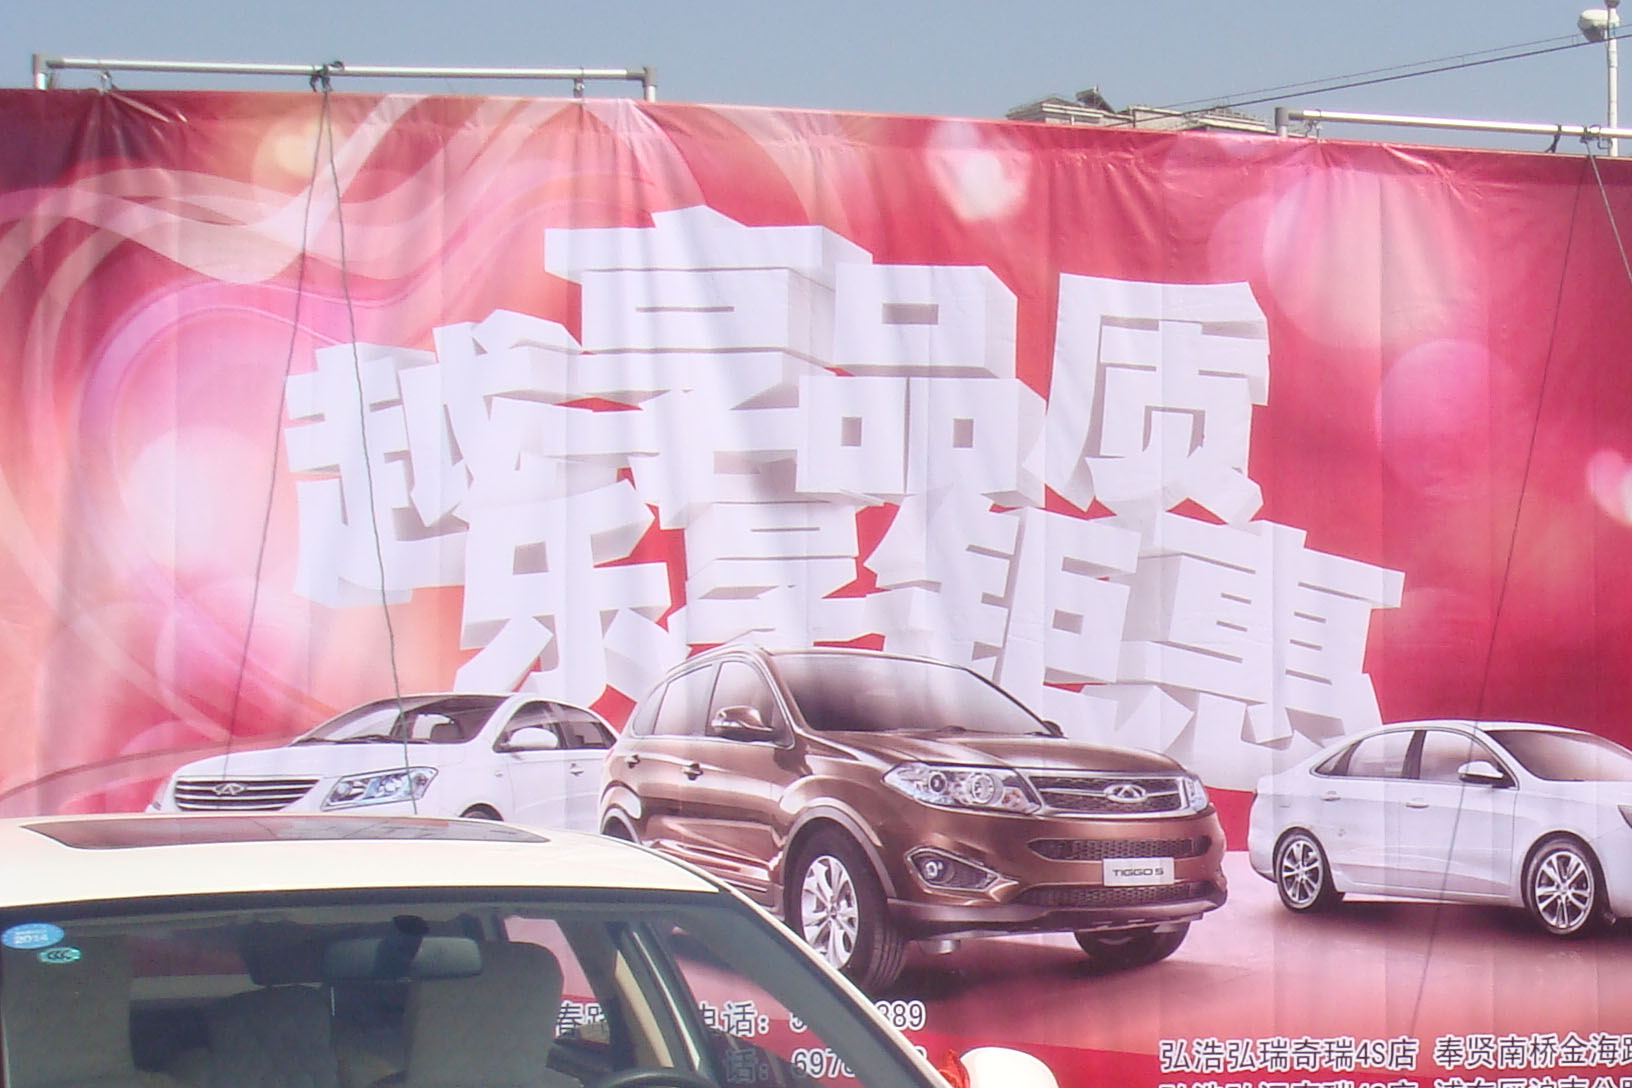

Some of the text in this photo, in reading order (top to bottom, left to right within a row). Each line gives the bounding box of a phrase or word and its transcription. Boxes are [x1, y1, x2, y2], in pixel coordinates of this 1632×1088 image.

[1159, 1036, 1419, 1073] 弘浩弘瑞奇瑞4S店
